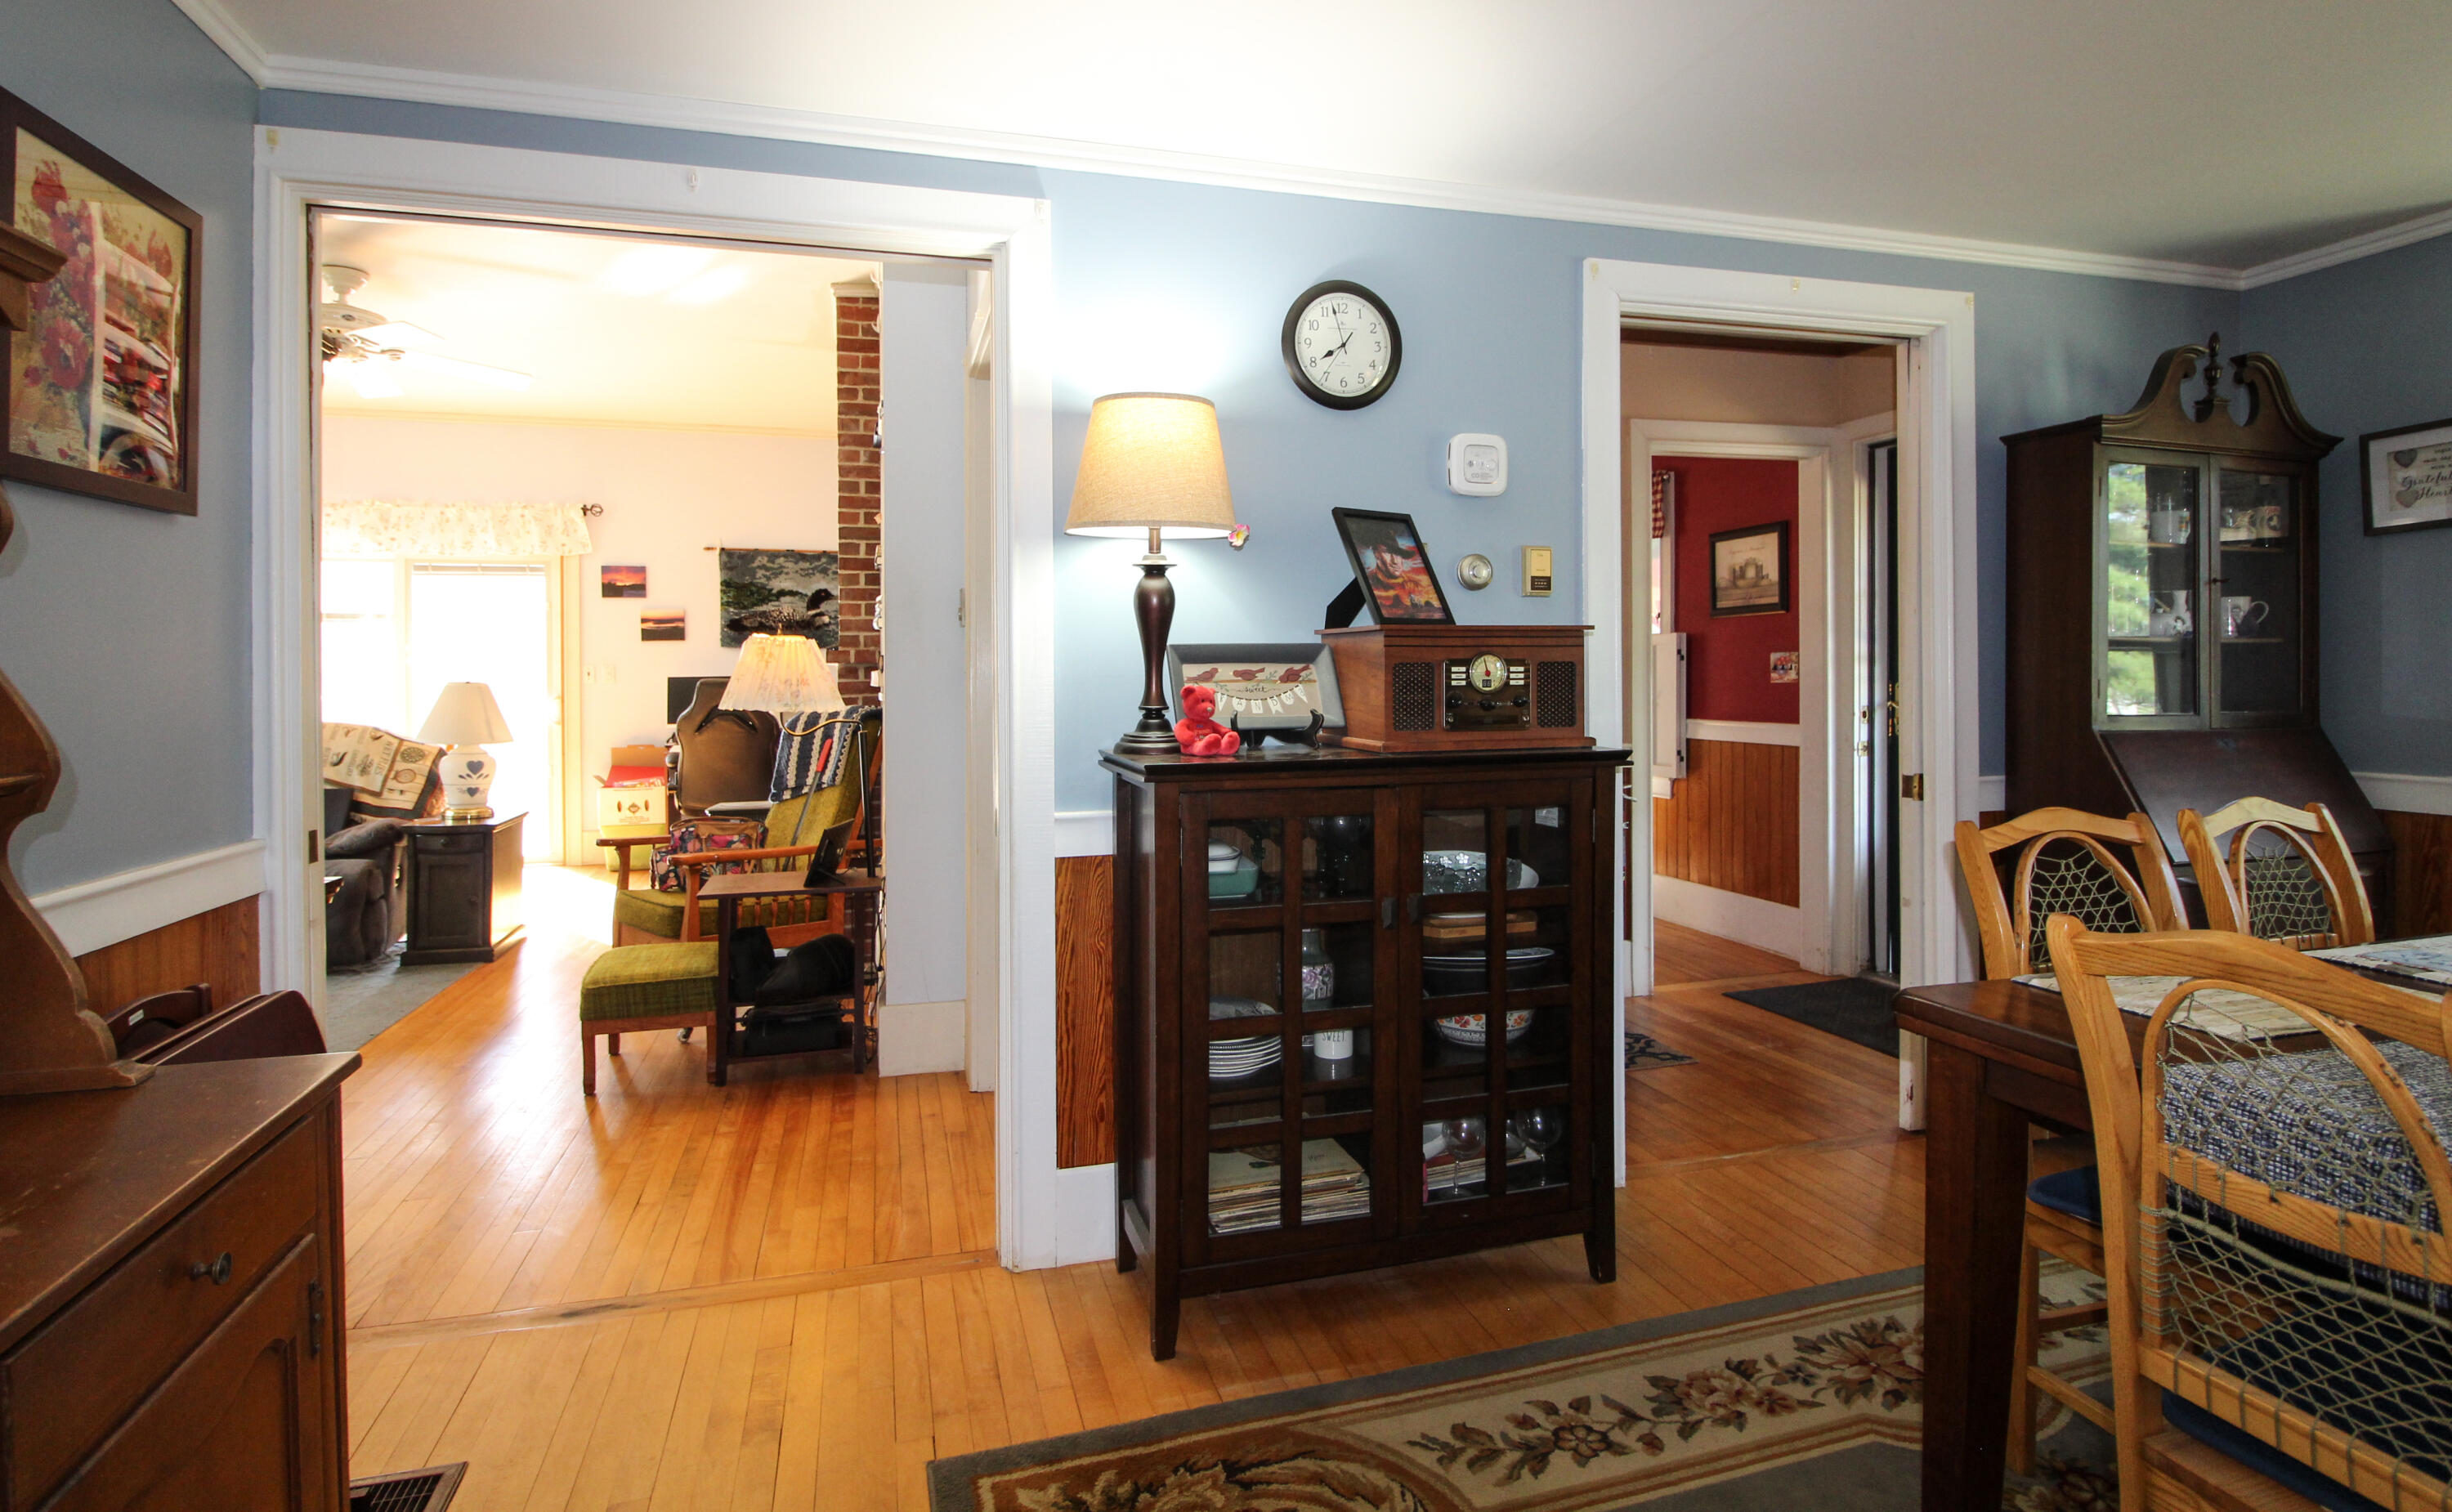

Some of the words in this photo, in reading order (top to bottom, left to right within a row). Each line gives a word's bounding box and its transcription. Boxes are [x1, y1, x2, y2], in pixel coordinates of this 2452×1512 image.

[1321, 306, 1329, 317] 11
[1337, 303, 1349, 314] 12
[1358, 309, 1362, 319] 1
[1309, 320, 1319, 331] 10
[1370, 323, 1377, 334] 2
[1304, 338, 1312, 348] 9
[1374, 342, 1381, 352] 3
[1309, 357, 1317, 368] 8
[1369, 360, 1376, 370] 4
[1323, 372, 1331, 382] 7
[1340, 377, 1348, 388] 6
[1358, 373, 1365, 384] 5
